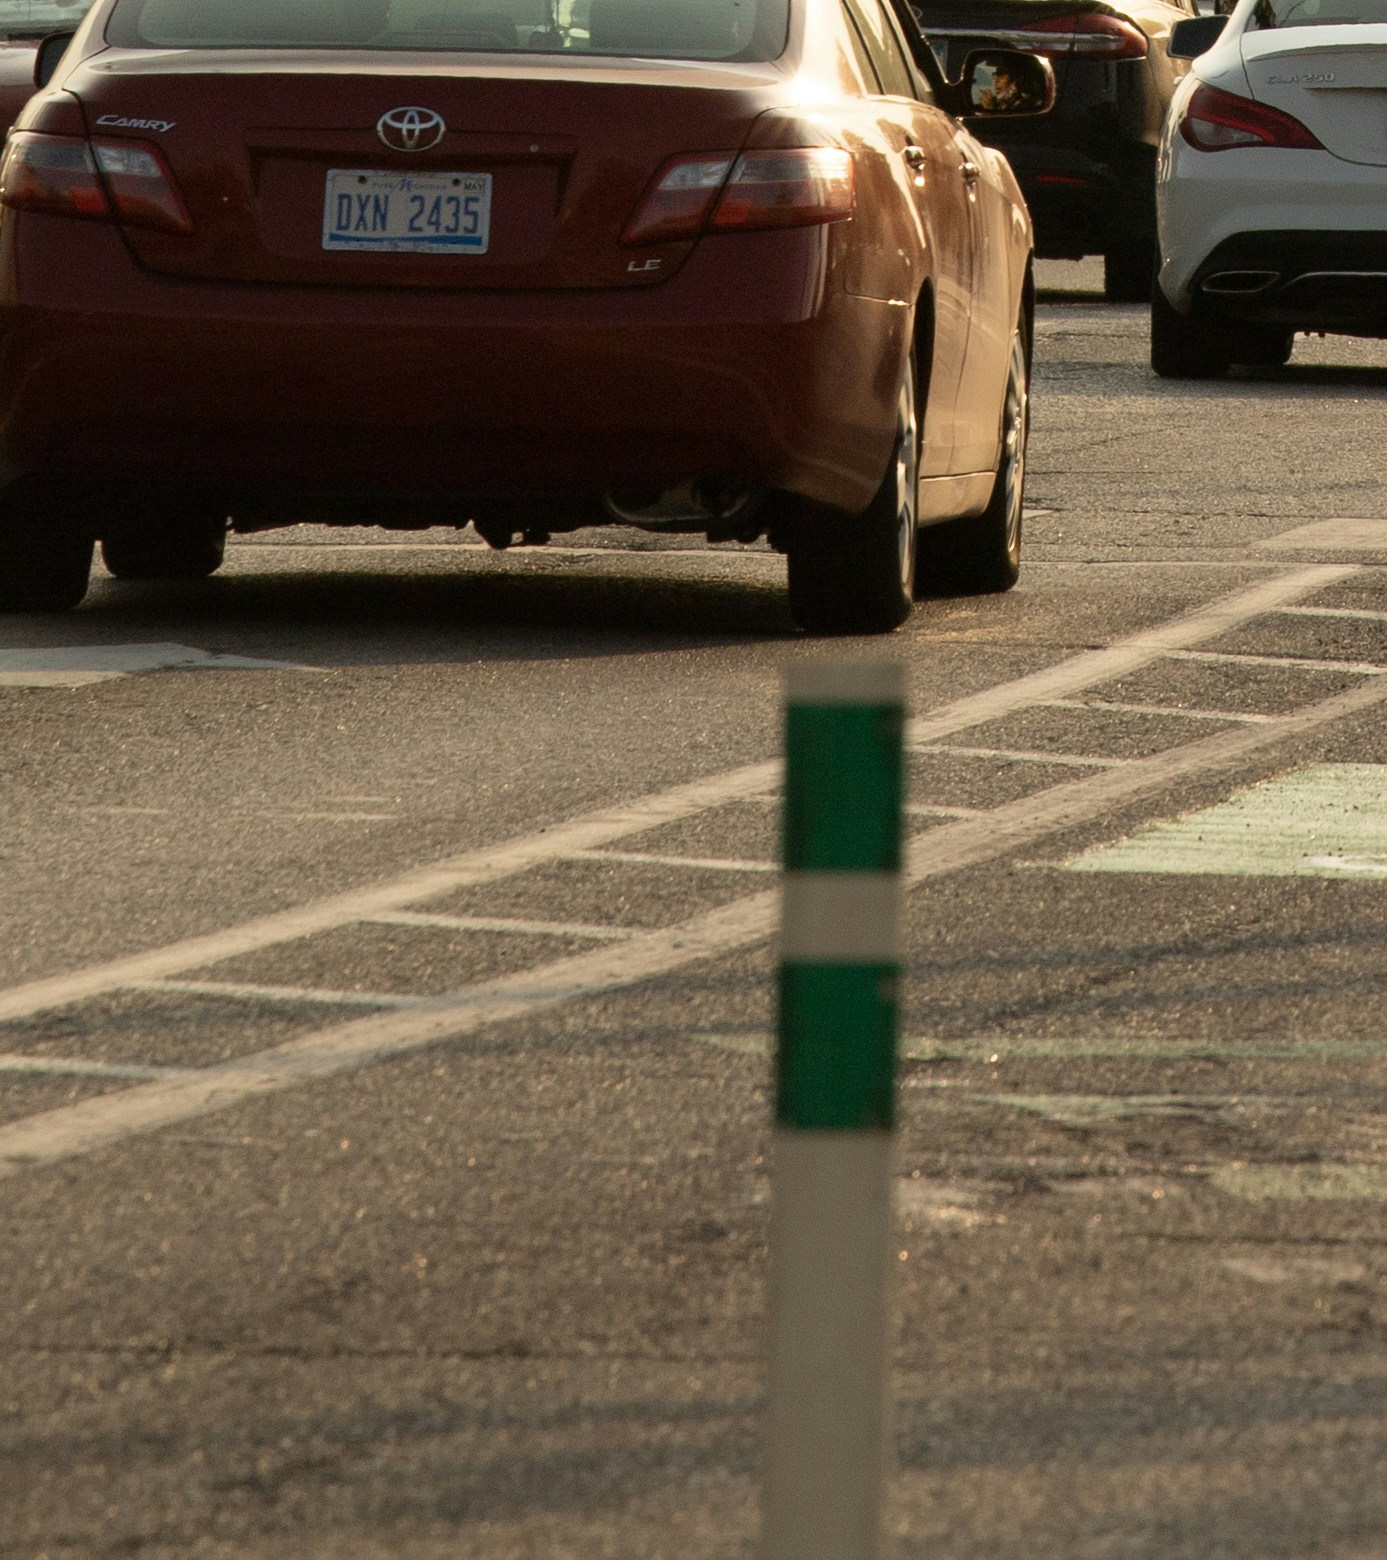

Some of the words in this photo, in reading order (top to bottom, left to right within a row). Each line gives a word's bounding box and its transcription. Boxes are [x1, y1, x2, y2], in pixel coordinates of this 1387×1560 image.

[95, 114, 177, 132] CAMRY
[336, 193, 389, 232] DXN
[407, 194, 480, 234] 2435
[627, 258, 662, 272] LE
